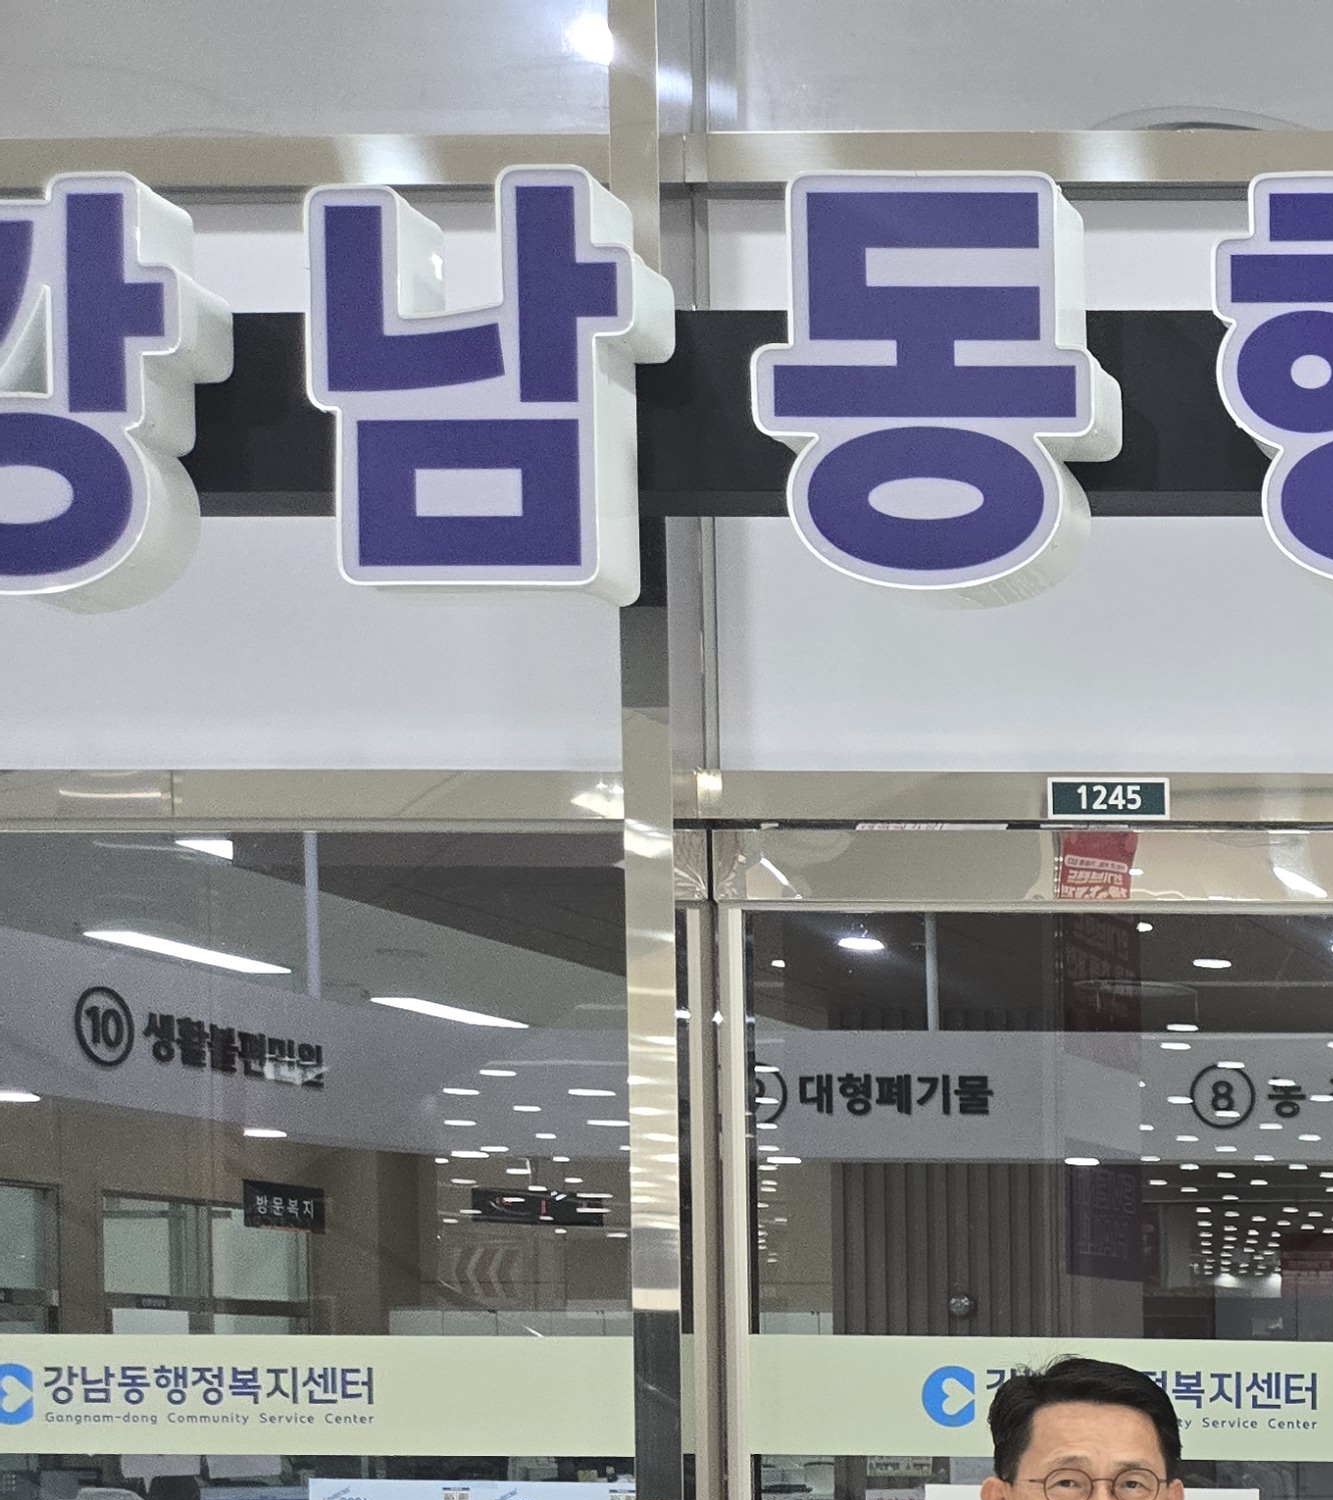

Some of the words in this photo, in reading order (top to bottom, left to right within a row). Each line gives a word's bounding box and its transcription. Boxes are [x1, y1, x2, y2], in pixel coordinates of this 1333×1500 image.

[1075, 785, 1142, 811] 1245
[798, 1073, 995, 1117] 대형폐기물
[44, 1364, 375, 1406] 강남동행정복지센터
[45, 1412, 158, 1425] Gangnam-dong
[167, 1412, 249, 1425] Community
[260, 1413, 315, 1424] Service
[324, 1413, 375, 1425] Center
[1202, 1417, 1258, 1430] Service
[1267, 1418, 1318, 1431] Center
